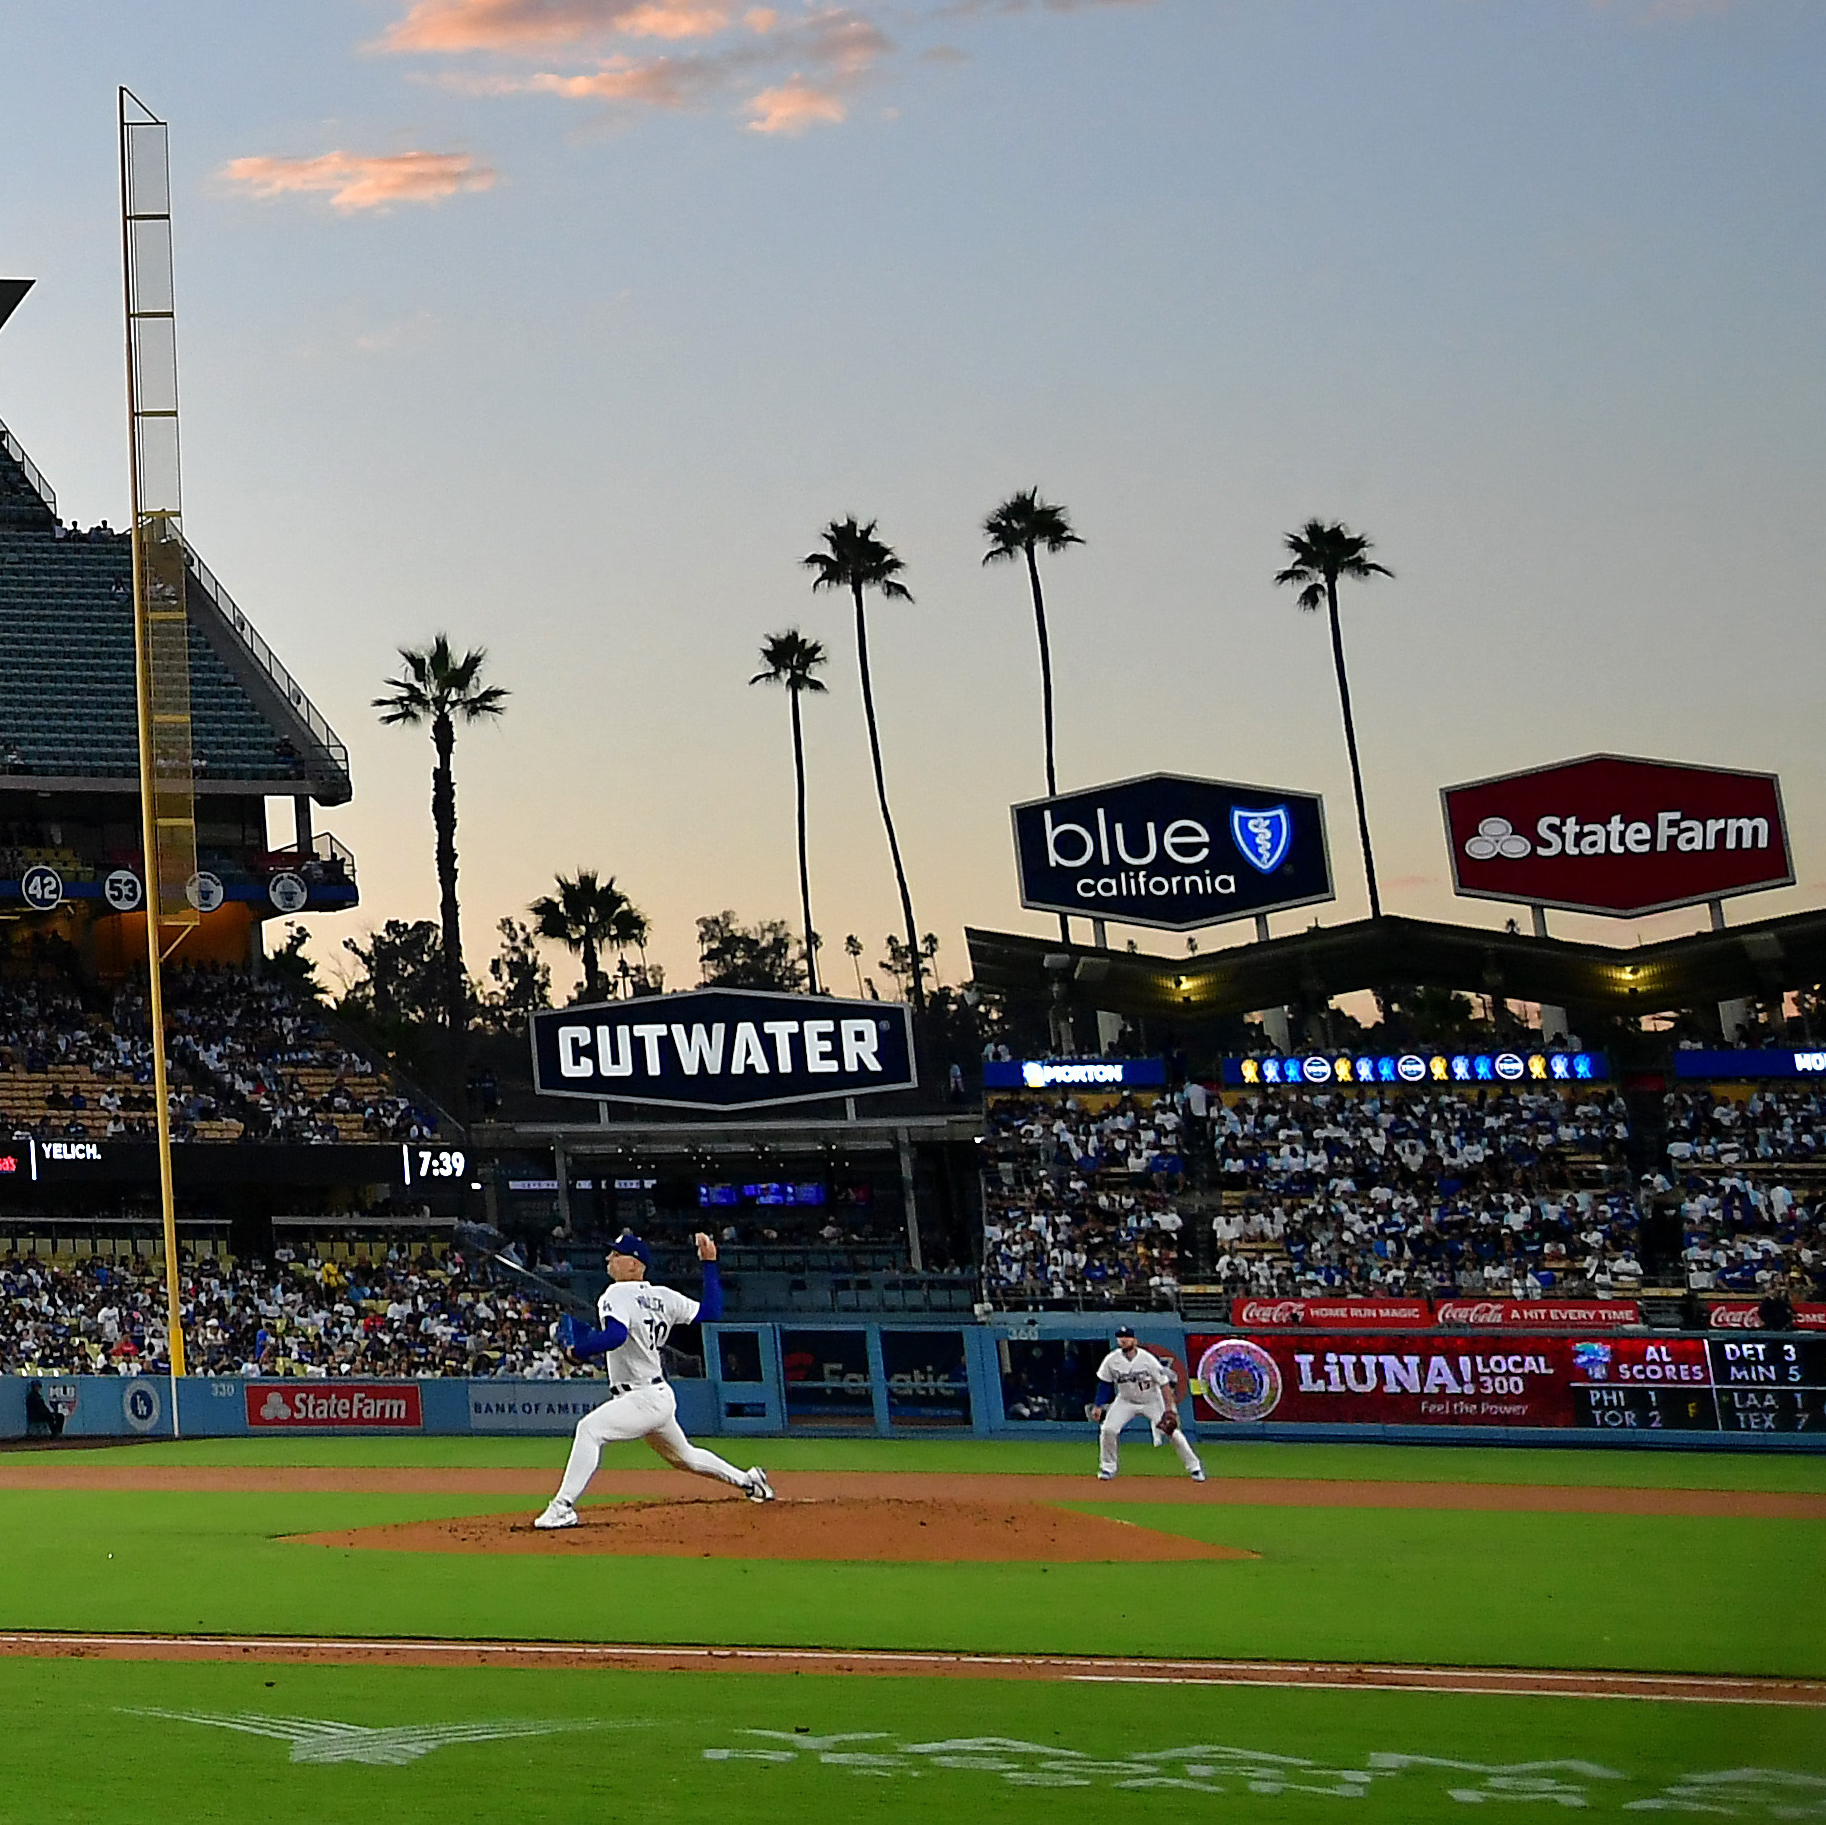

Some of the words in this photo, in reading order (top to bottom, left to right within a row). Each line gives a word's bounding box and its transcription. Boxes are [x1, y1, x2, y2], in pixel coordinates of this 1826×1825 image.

[1043, 807, 1211, 870] blue
[27, 874, 57, 900] 42
[108, 877, 137, 902] 53
[1076, 867, 1237, 900] california
[557, 1019, 883, 1079] CUTWATER
[1044, 1063, 1123, 1084] MORTON
[41, 1143, 101, 1161] YELICH.
[418, 1151, 466, 1178] 7:39
[1309, 1306, 1348, 1318] HOME
[1350, 1307, 1378, 1318] RUN
[1379, 1308, 1420, 1319] MAGIC
[1437, 1302, 1504, 1325] Coca-Cola
[1510, 1309, 1522, 1320] A
[1523, 1309, 1549, 1320] HIT
[1550, 1309, 1597, 1321] EVERY
[1598, 1309, 1635, 1322] TIME
[643, 1318, 669, 1351] 70
[1644, 1345, 1673, 1362] AL
[1724, 1343, 1767, 1362] DET
[1783, 1345, 1797, 1362] 3
[1294, 1352, 1477, 1395] LiUNA!
[1476, 1354, 1554, 1376] LOCAL
[1618, 1363, 1705, 1381] SCORES
[1729, 1365, 1776, 1382] MIN
[1787, 1365, 1802, 1383] 5
[211, 1383, 235, 1397] 330
[1479, 1375, 1524, 1395] 300
[1589, 1389, 1625, 1407] PHI
[1649, 1391, 1657, 1407] 1
[1732, 1391, 1780, 1410] LAA
[473, 1401, 515, 1415] BANK
[521, 1401, 540, 1415] OF
[1421, 1400, 1451, 1416] Feel
[1453, 1400, 1478, 1415] the
[1481, 1402, 1529, 1417] Power
[1591, 1409, 1637, 1427] TOR
[1648, 1410, 1663, 1428] 2
[1735, 1412, 1777, 1430] TEX
[1794, 1413, 1810, 1431] 7
